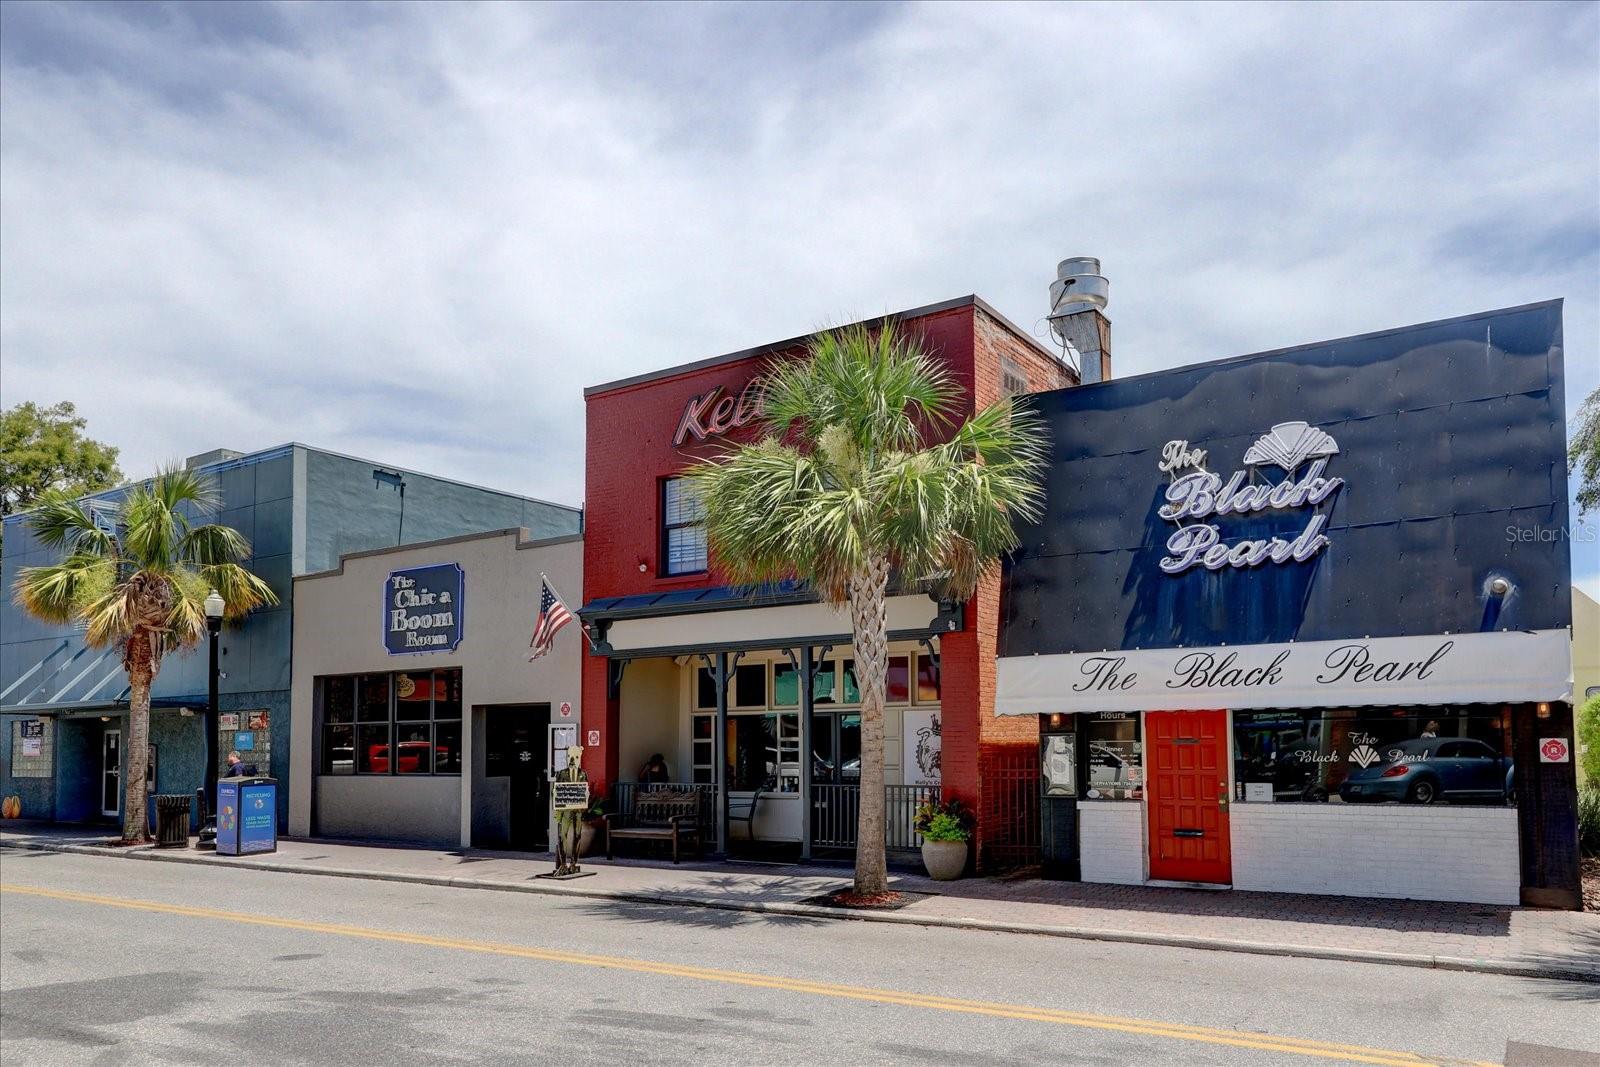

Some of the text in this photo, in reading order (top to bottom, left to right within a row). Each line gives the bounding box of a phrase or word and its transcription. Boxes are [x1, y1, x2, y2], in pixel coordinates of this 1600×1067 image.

[1158, 440, 1208, 472] The
[1157, 456, 1346, 521] Black
[1159, 514, 1330, 573] Pearl
[391, 575, 416, 589] The
[394, 588, 452, 608] Chic a
[390, 608, 455, 632] Boom
[404, 631, 448, 647] Room
[1072, 641, 1454, 692] The Black Pearl
[1100, 711, 1126, 719] Hours
[1347, 731, 1379, 745] The
[1294, 749, 1430, 763] Black Pearl
